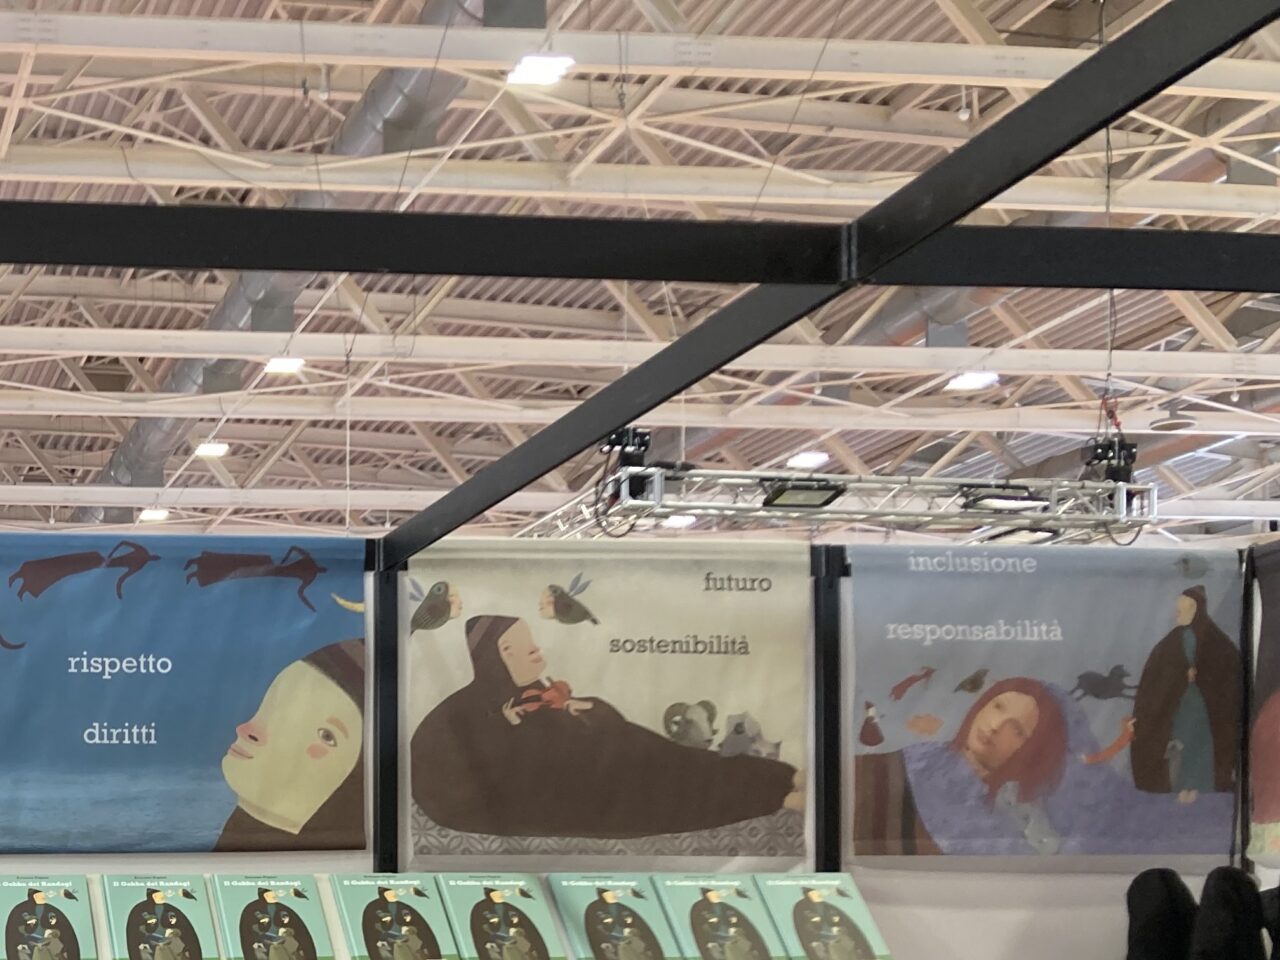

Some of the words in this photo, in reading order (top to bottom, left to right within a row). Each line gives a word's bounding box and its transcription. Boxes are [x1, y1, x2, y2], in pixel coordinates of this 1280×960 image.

[908, 551, 1037, 574] inclusione
[703, 572, 772, 592] futuro
[885, 620, 1063, 646] responsabilità
[609, 634, 750, 656] sostenibilità
[67, 651, 173, 679] rispetto
[83, 722, 157, 745] diritti
